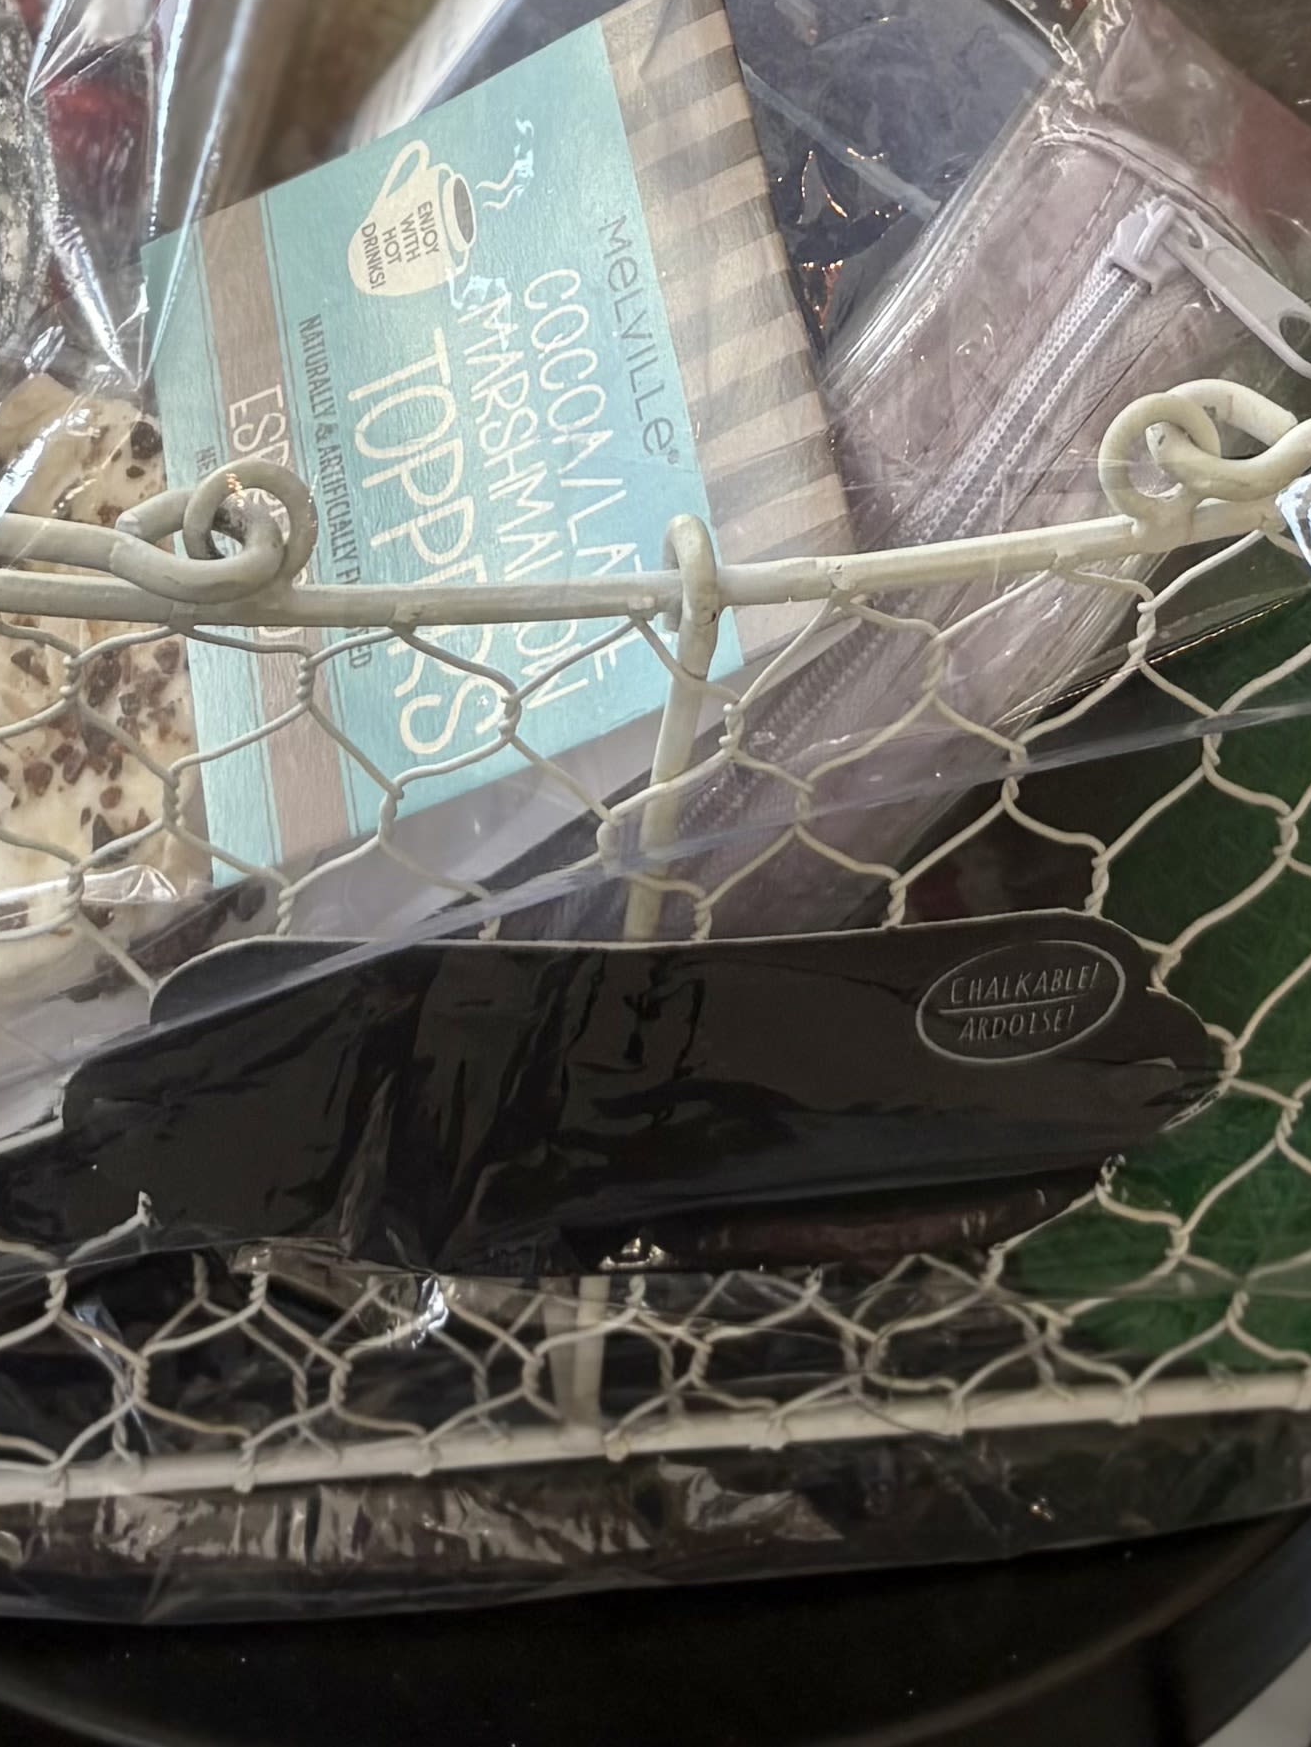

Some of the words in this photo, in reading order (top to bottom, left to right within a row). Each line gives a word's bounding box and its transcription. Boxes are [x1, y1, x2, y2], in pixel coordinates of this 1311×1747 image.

[382, 227, 403, 265] HOT
[399, 212, 422, 263] WITH
[417, 201, 441, 254] ENJOY
[361, 222, 388, 290] DRINKS!
[299, 313, 336, 420] NATURALLY
[315, 422, 333, 446] &
[317, 442, 359, 563] ARTIFICIALLY
[457, 291, 590, 710] MARSHMALOW
[951, 962, 1100, 1005] CHALKABLE!
[958, 1004, 1075, 1041] ARDOISE!
